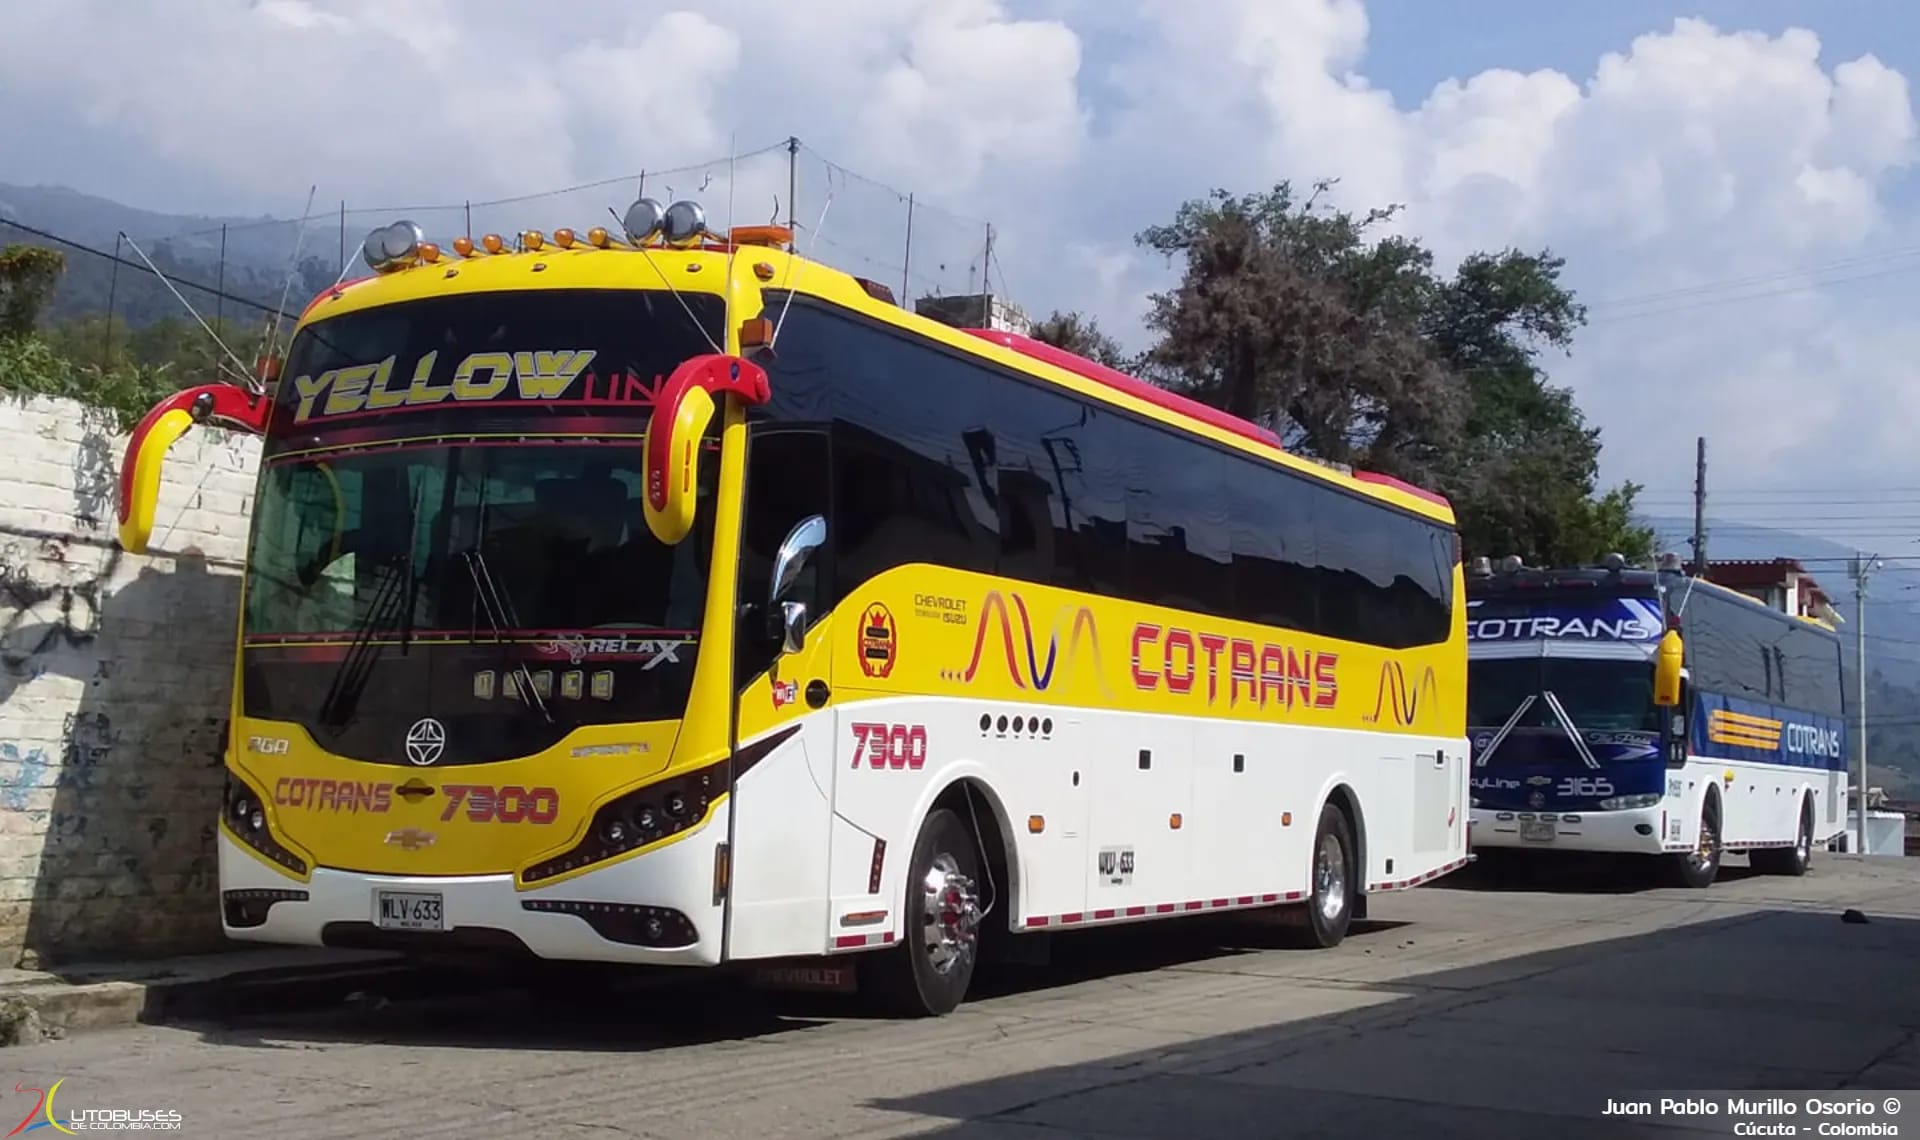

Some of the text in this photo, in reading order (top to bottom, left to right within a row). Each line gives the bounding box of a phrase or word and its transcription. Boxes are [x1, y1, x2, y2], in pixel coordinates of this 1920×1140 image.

[294, 350, 597, 424] YELLOW
[914, 594, 967, 612] CHEVROLET
[589, 639, 681, 670] RELAX
[1131, 622, 1338, 712] COTRANS
[850, 722, 927, 770] 7300
[1787, 722, 1840, 758] COTRANS
[276, 777, 560, 825] COTRANS 7300
[1557, 777, 1614, 796] 3165
